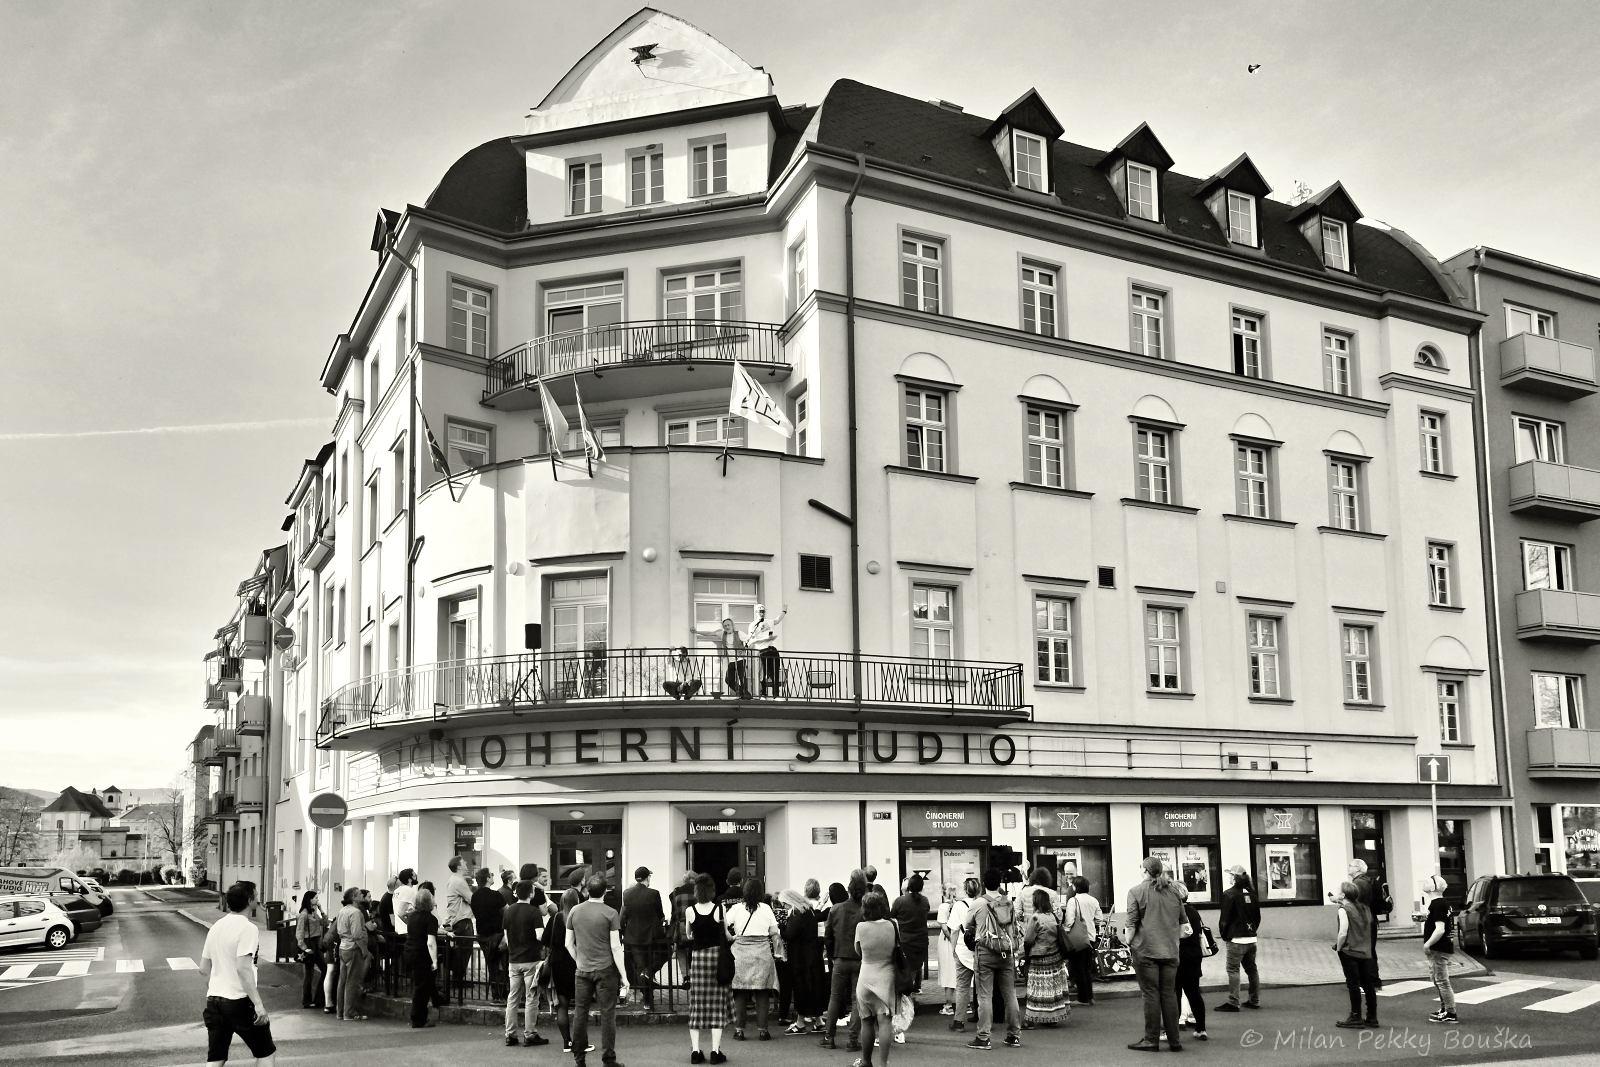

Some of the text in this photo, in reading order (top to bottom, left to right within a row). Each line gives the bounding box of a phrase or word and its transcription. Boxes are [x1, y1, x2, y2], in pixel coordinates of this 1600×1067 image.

[795, 727, 1017, 766] STUDIO
[925, 810, 965, 821] ČINOHERNÍ
[1164, 811, 1197, 821] ČINOHERNÍ
[932, 821, 959, 829] STUDIO
